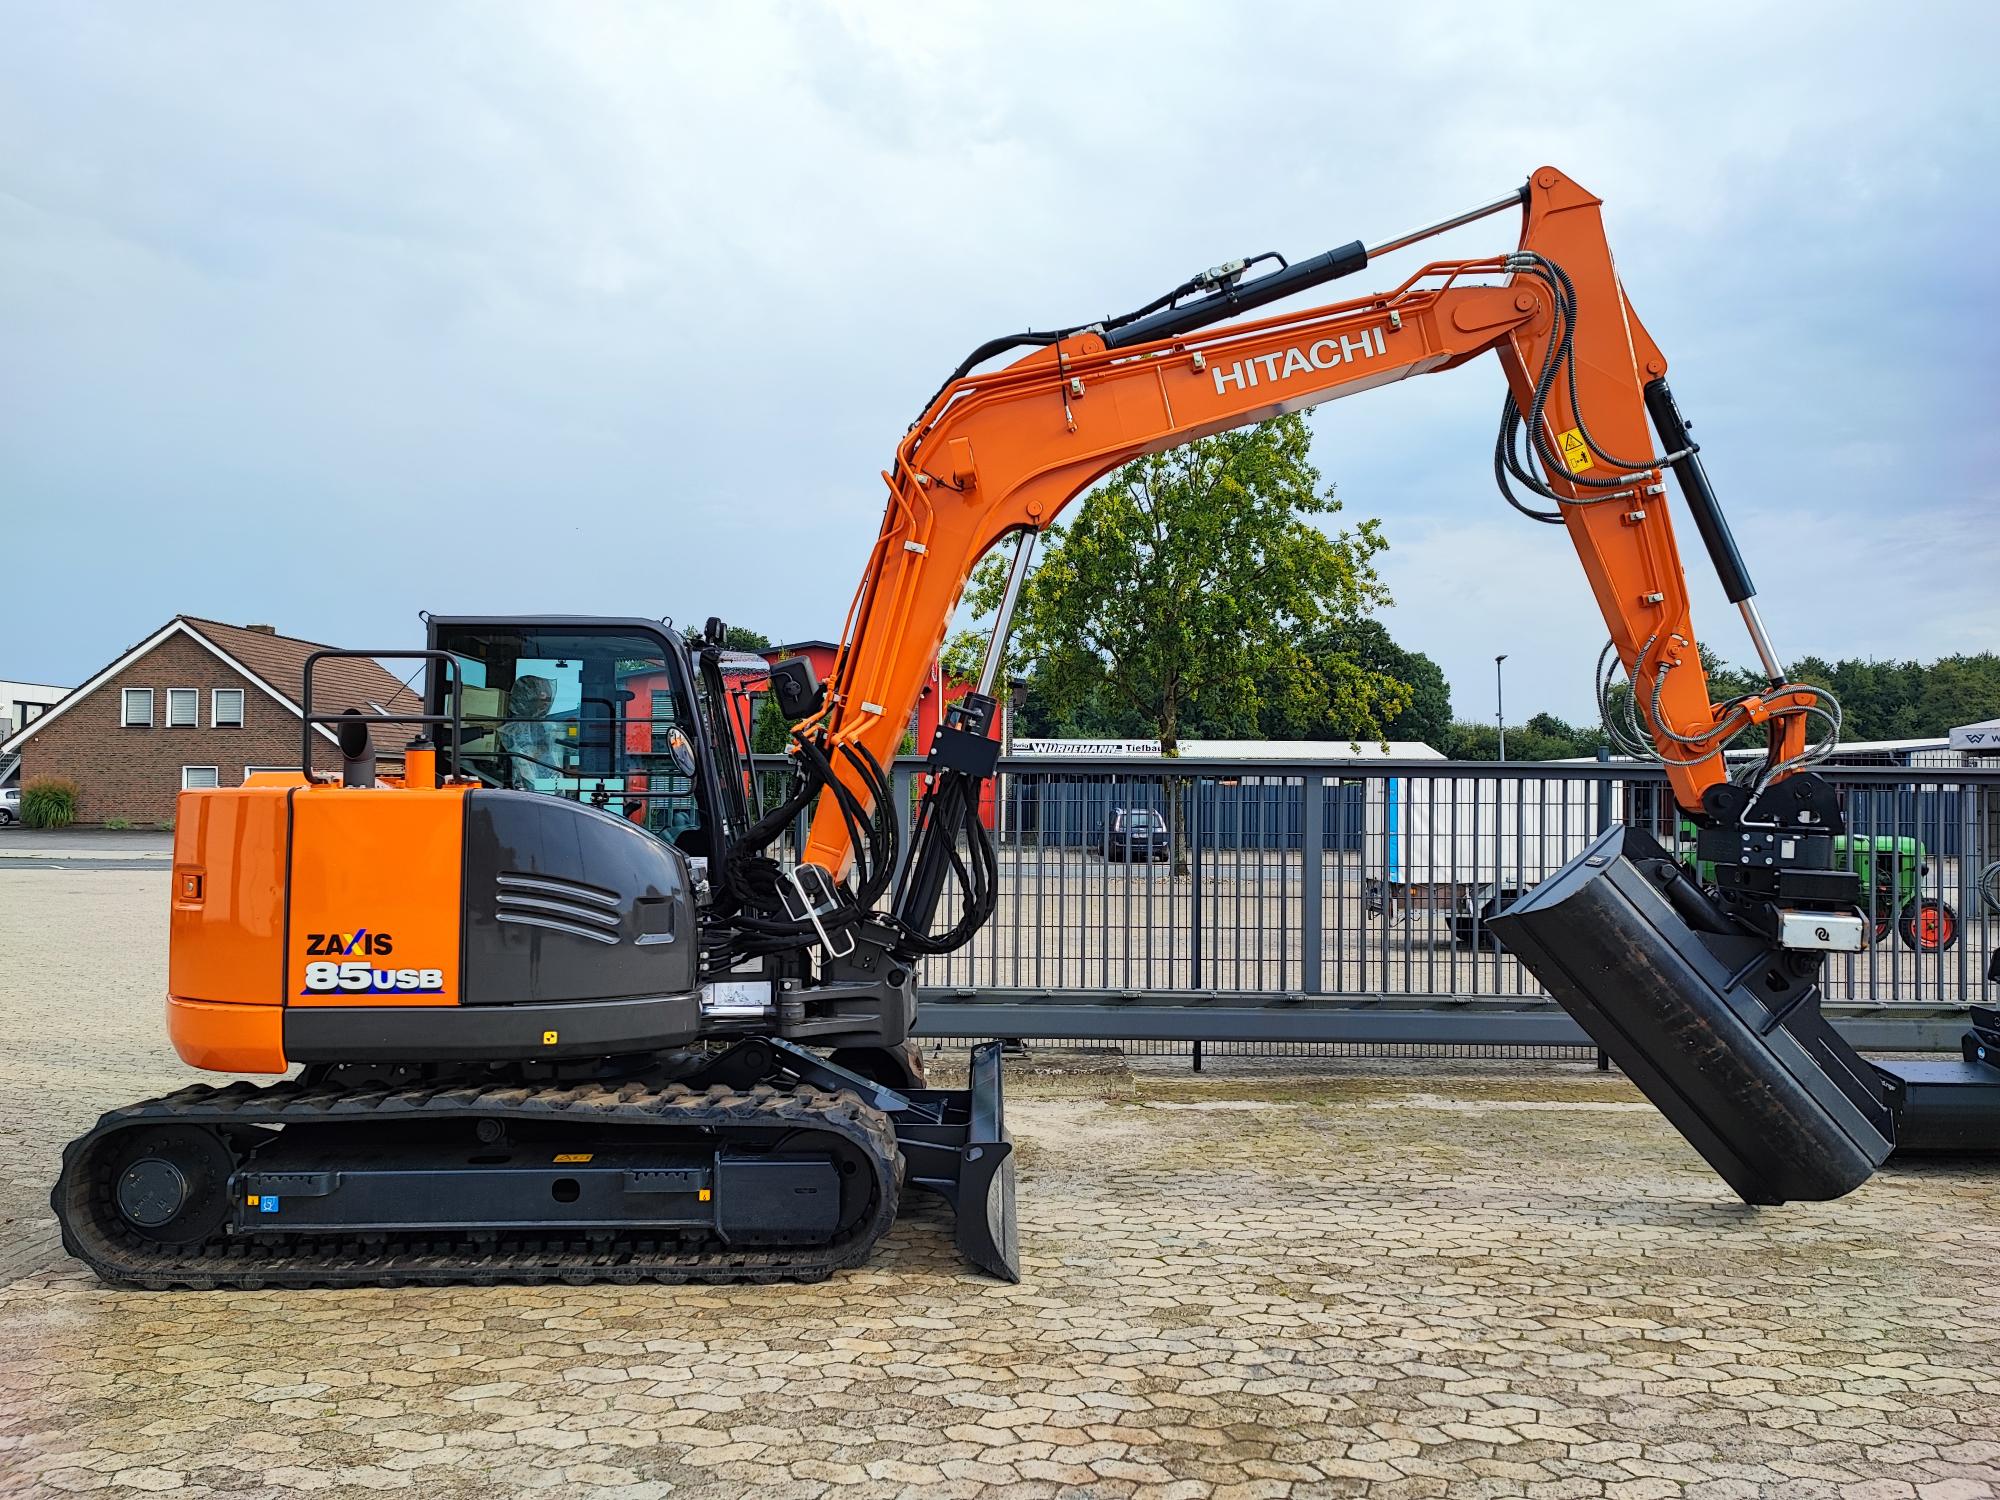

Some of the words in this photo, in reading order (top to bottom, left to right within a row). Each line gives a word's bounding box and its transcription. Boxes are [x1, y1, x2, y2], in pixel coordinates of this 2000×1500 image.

[1212, 326, 1387, 395] HITACHI
[1032, 742, 1117, 753] WÜRDEMANN
[306, 928, 393, 956] ZAXIS
[305, 961, 444, 991] 85USB
